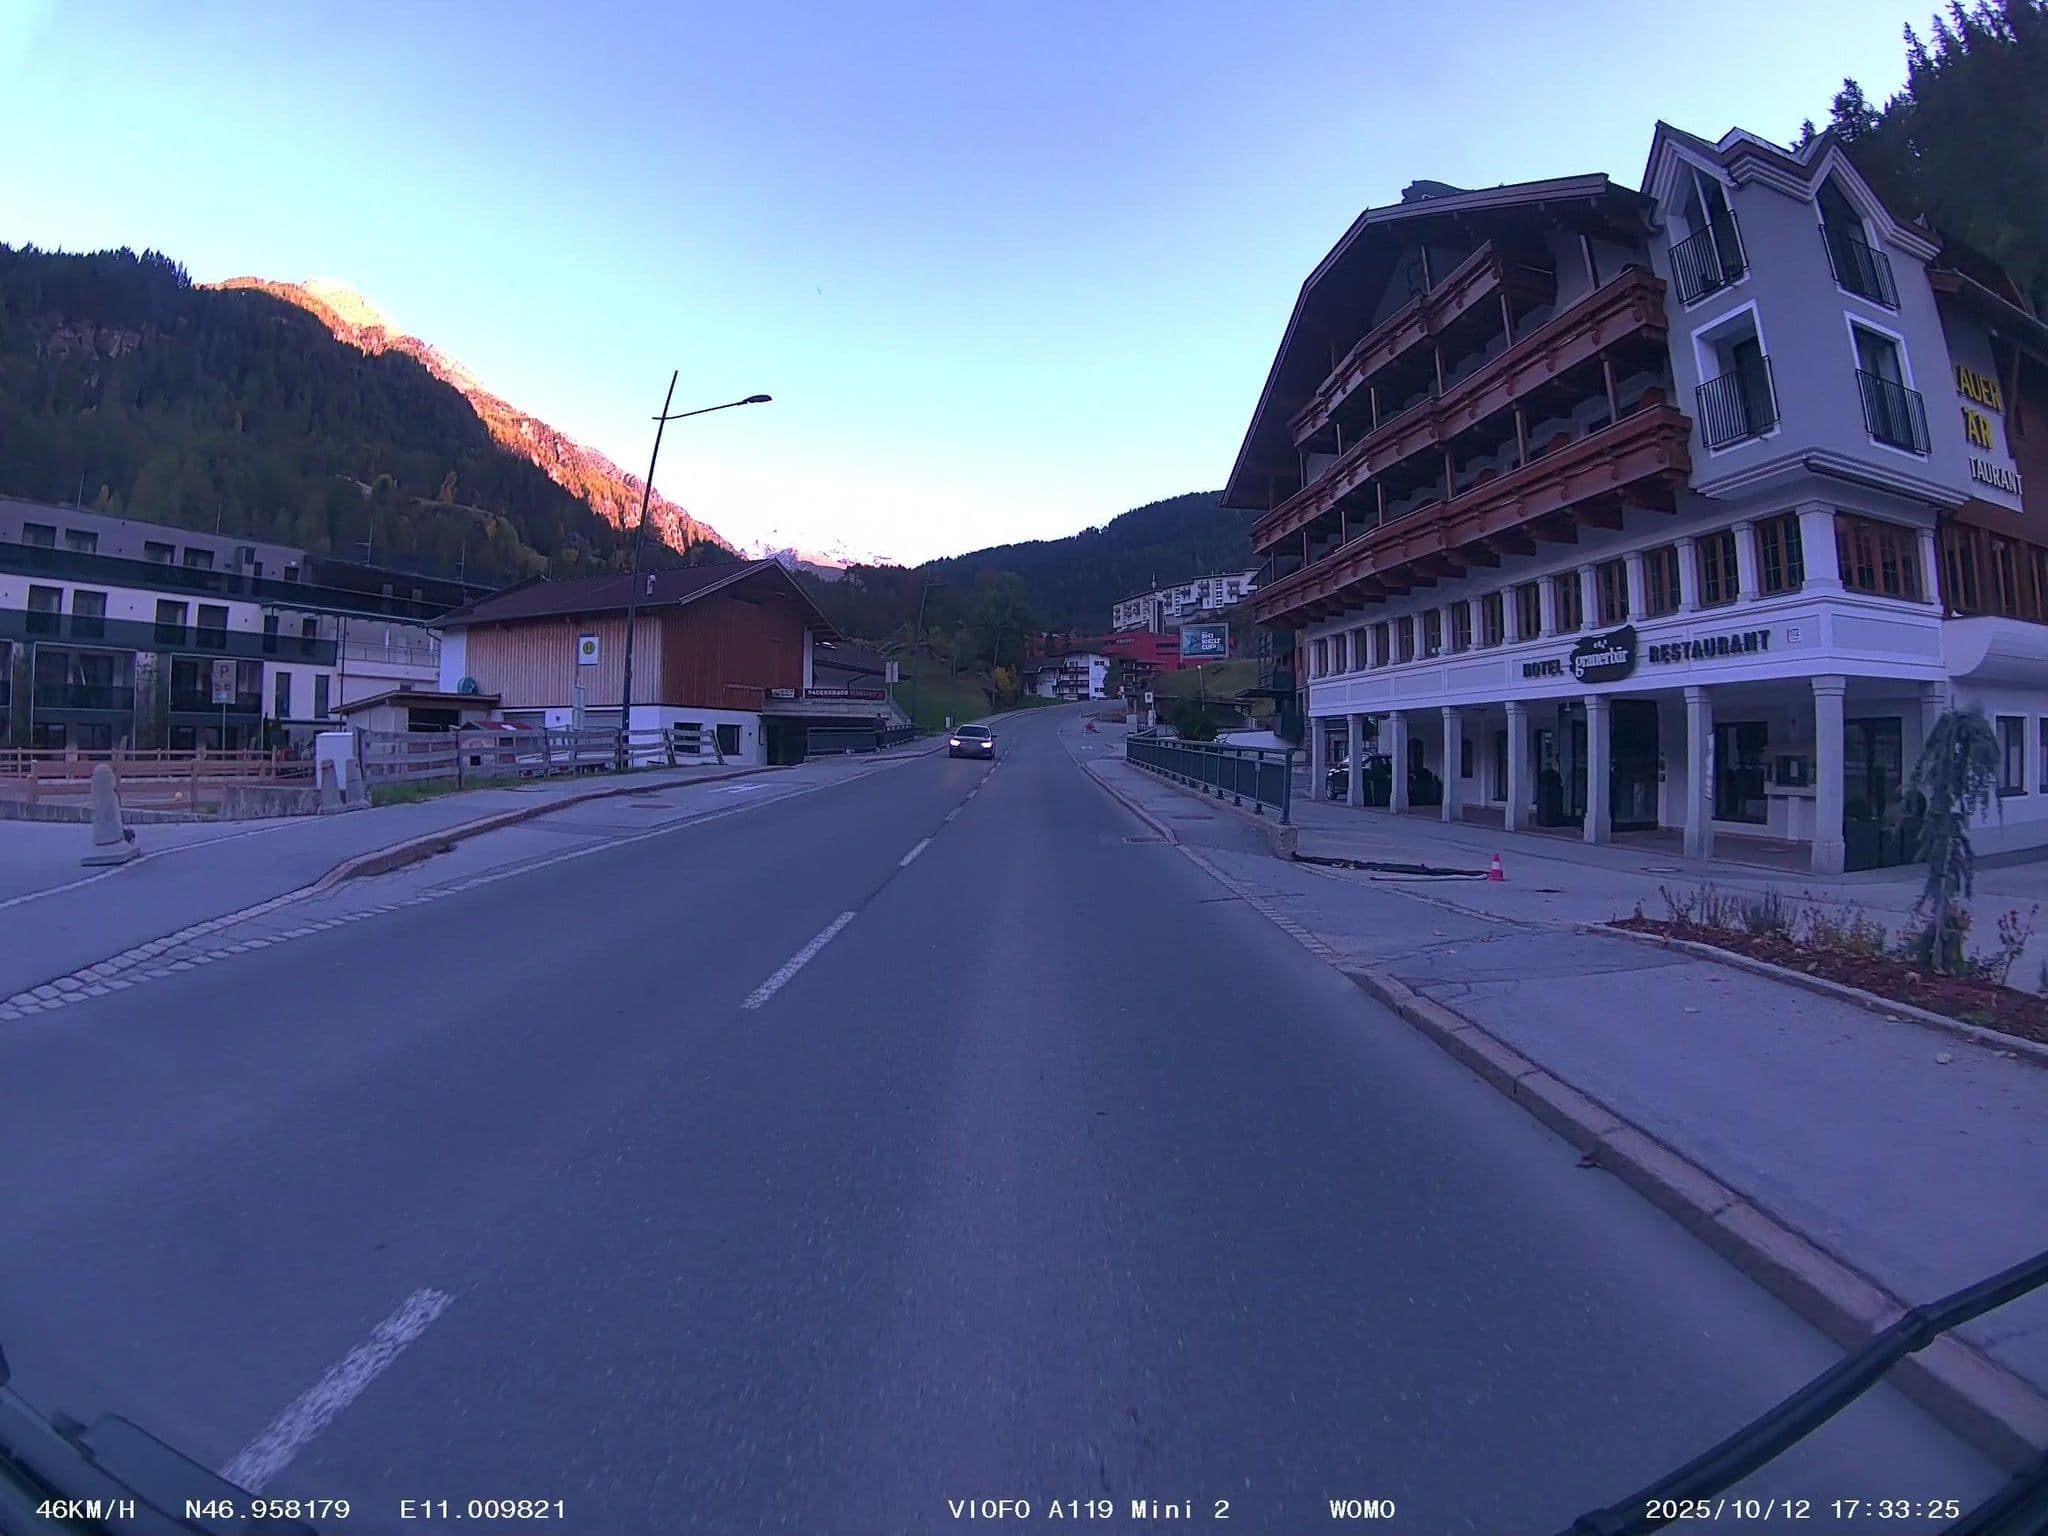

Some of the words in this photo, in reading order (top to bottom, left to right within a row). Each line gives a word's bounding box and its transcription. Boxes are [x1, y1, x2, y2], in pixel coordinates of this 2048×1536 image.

[1959, 368, 2003, 411] AUER
[1968, 456, 2023, 495] TAURANT
[220, 665, 229, 679] P
[1522, 659, 1564, 678] HOTEL
[1648, 629, 1770, 664] RESTAURANT
